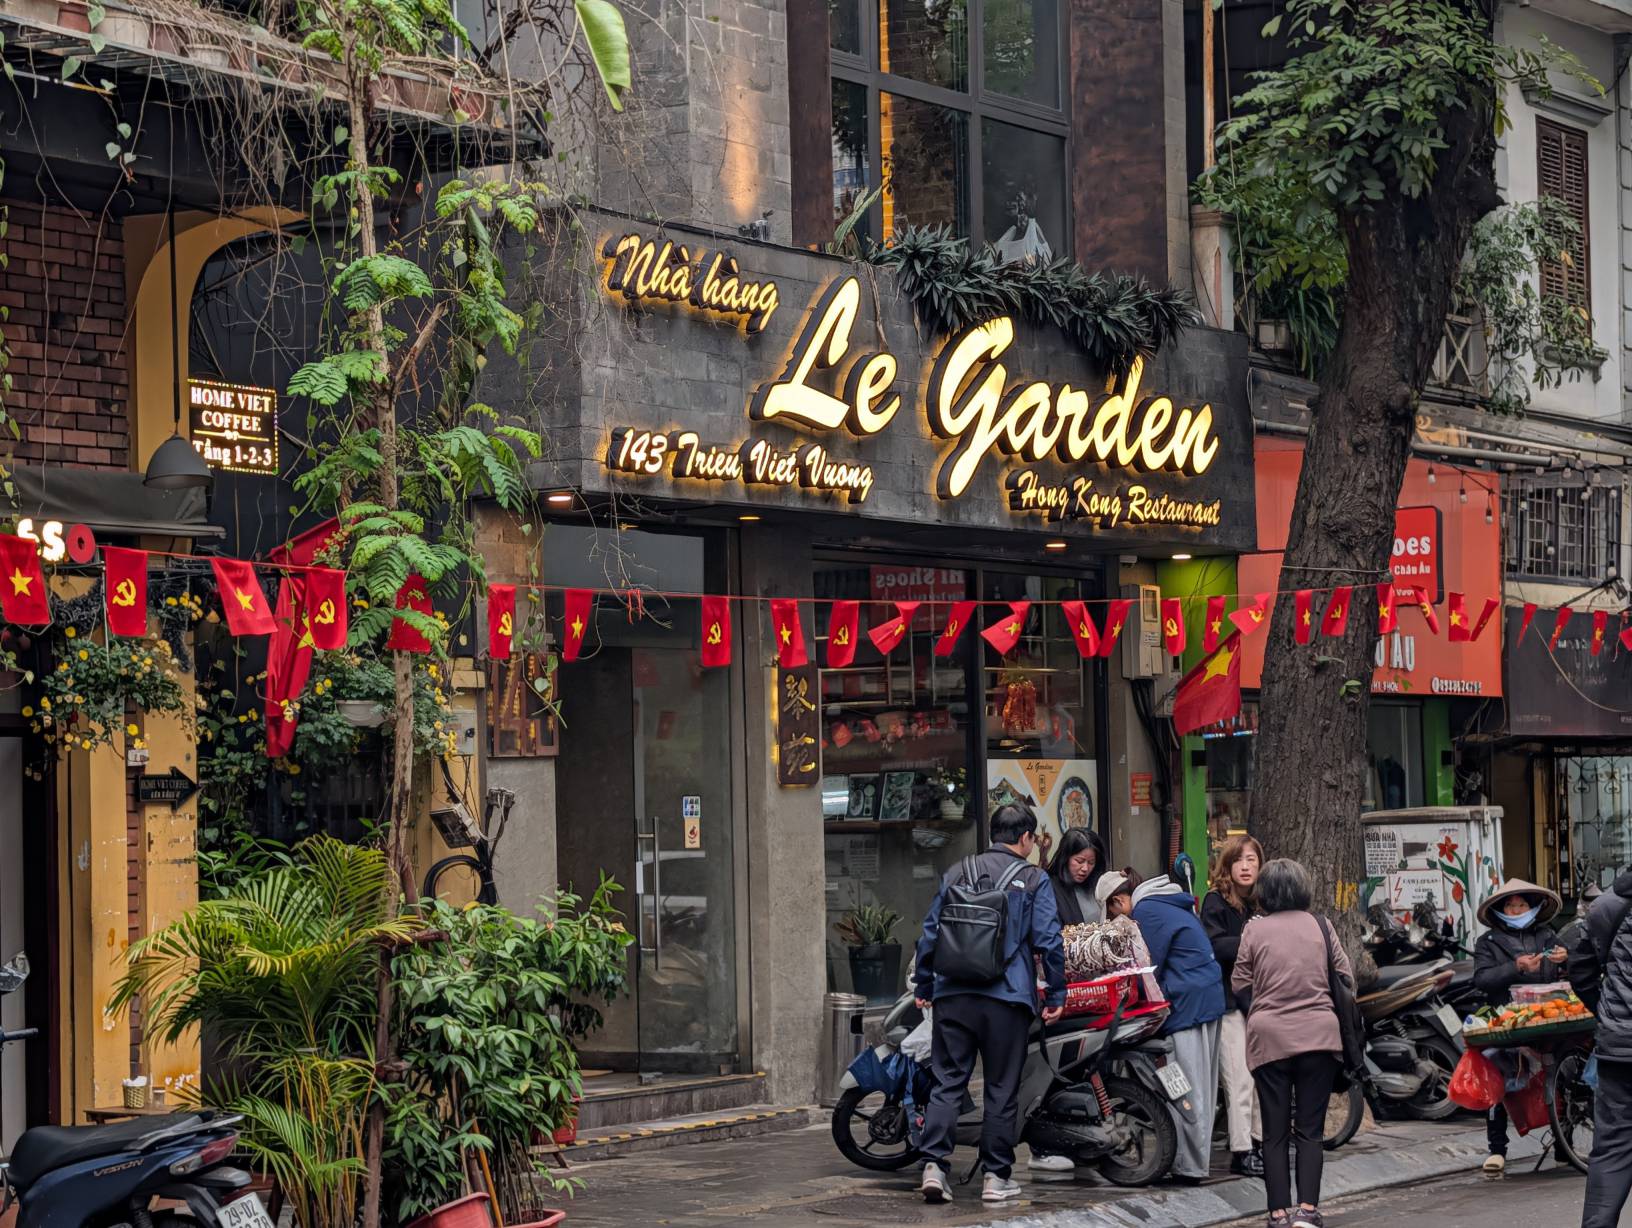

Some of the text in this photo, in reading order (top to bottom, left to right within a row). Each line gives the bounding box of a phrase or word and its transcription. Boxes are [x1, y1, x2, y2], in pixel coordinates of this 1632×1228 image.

[616, 235, 779, 331] Nhà hàng
[191, 386, 271, 413] HOME VIET
[762, 276, 1219, 497] Le Garden
[201, 410, 261, 432] COFFEE
[618, 428, 874, 503] 143 Trieu Viet Vuong
[1018, 470, 1221, 527] Hong Kong Restaurant
